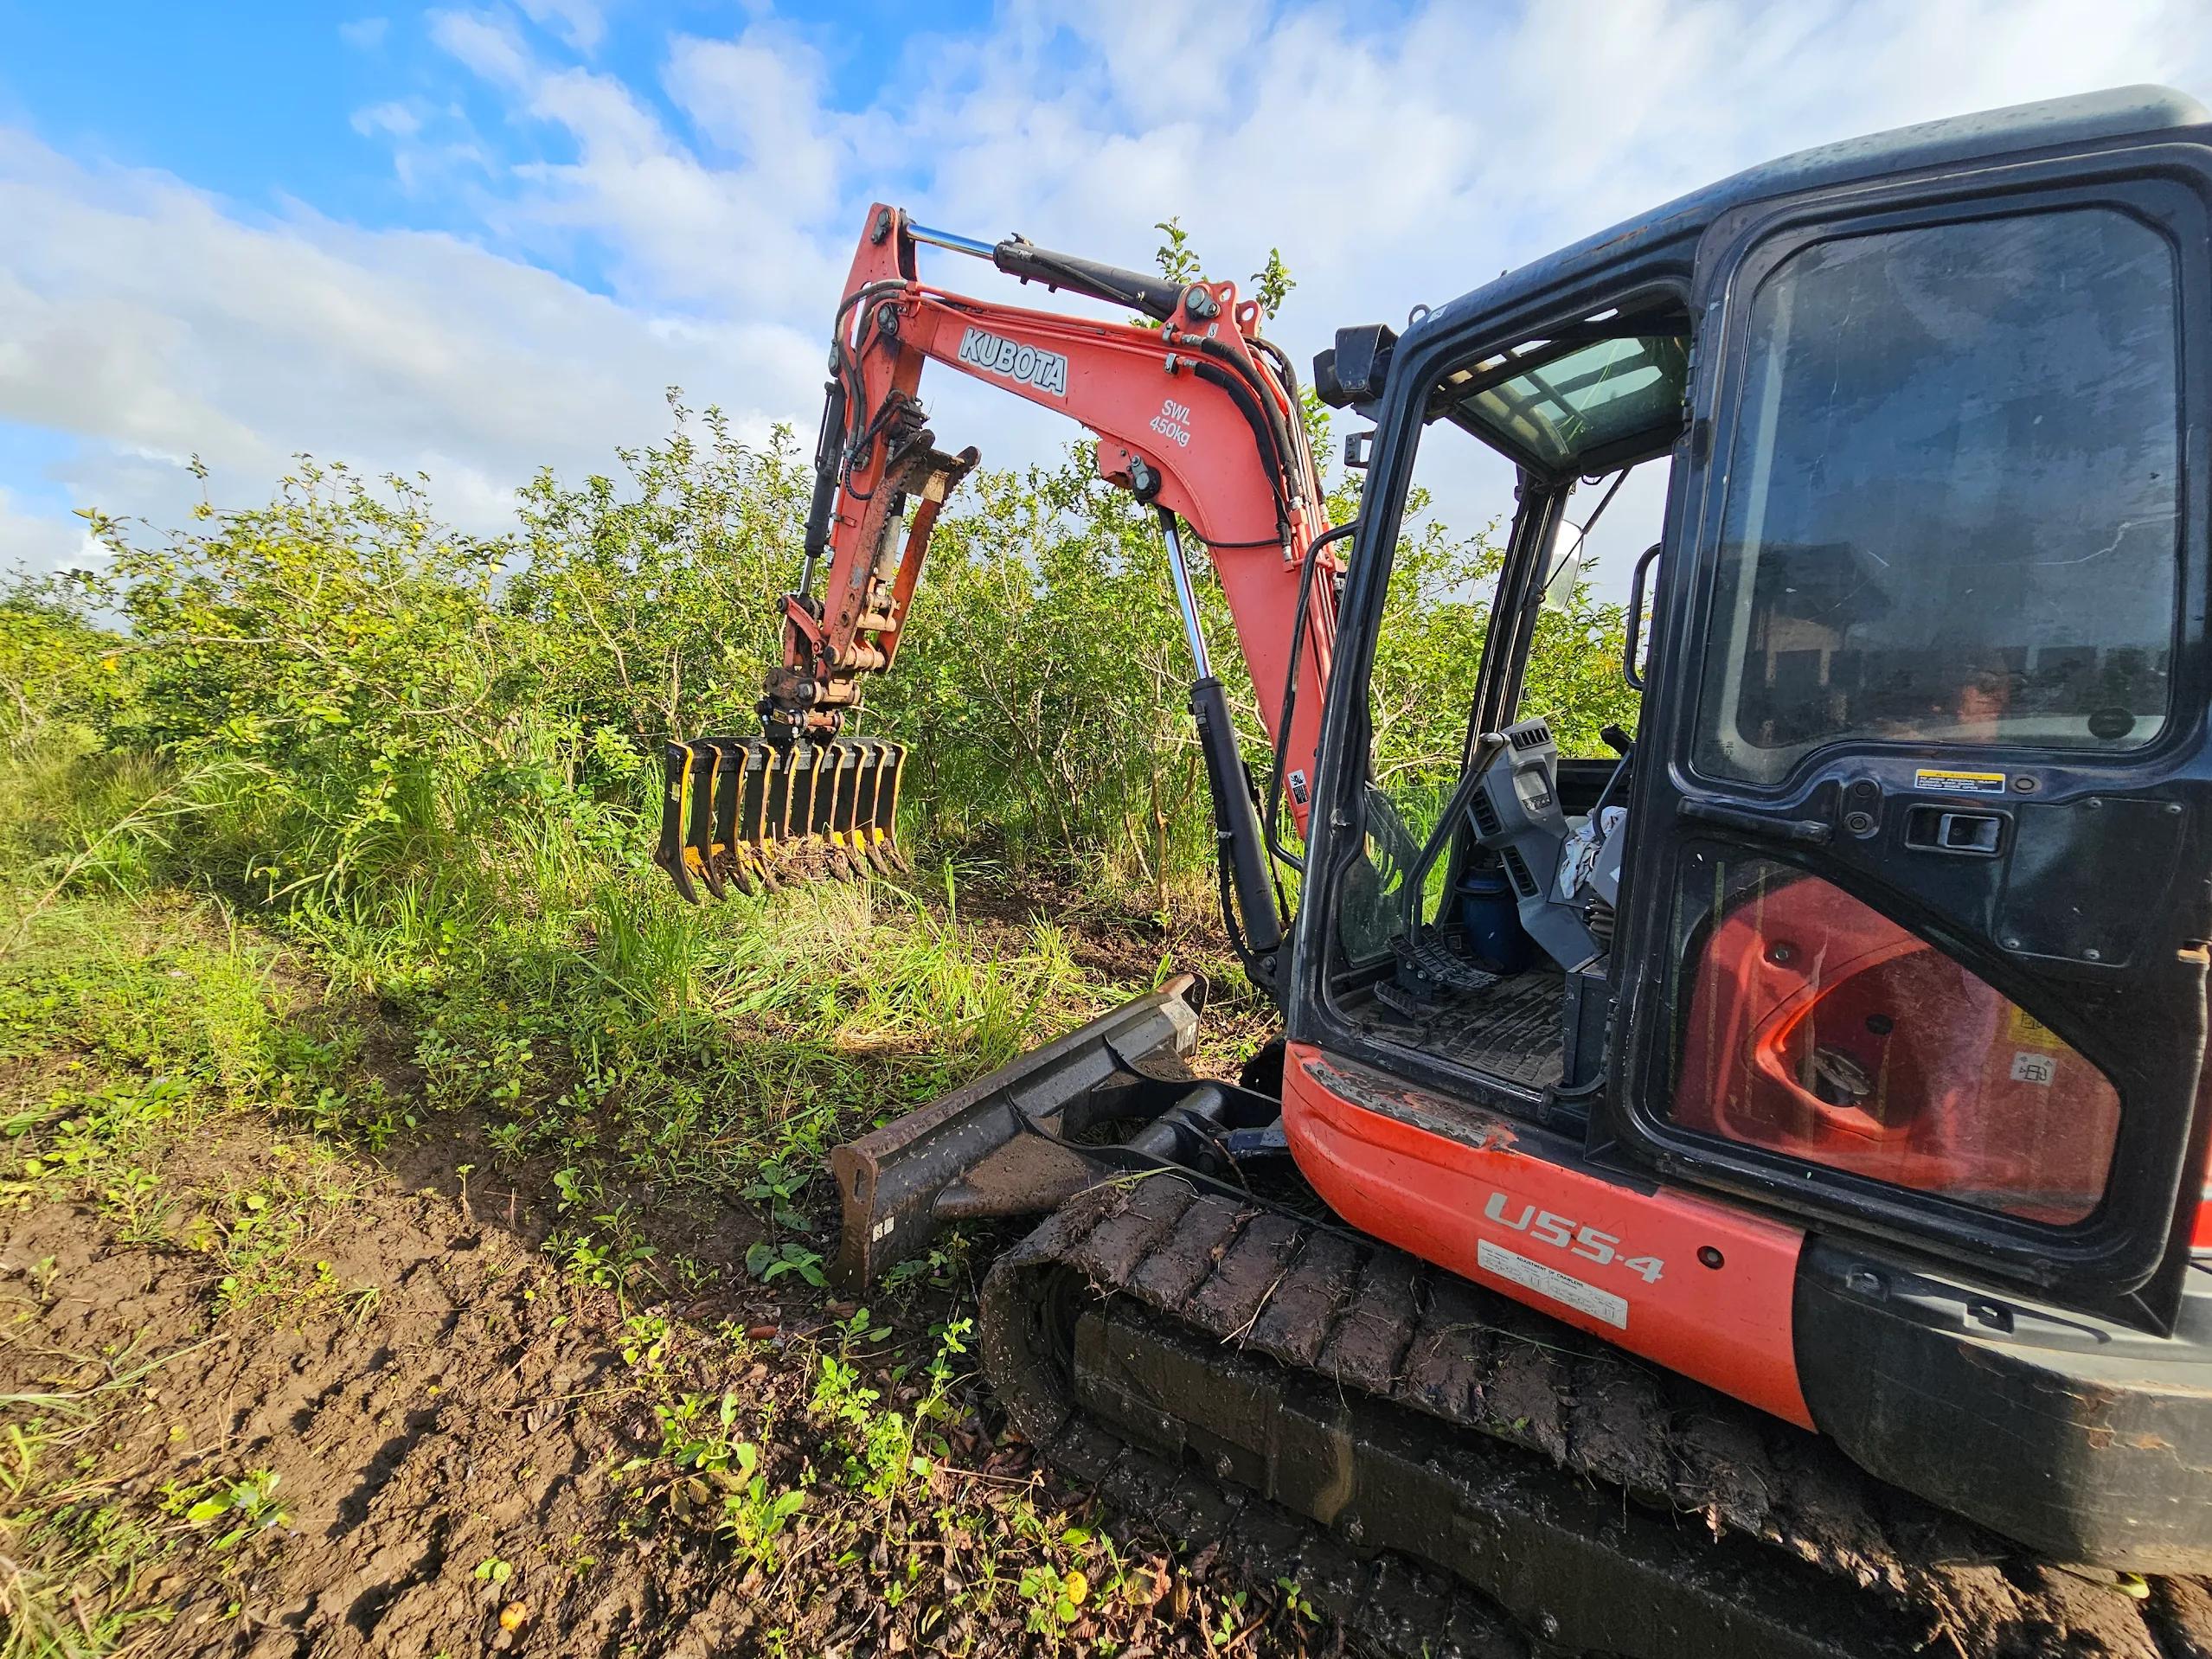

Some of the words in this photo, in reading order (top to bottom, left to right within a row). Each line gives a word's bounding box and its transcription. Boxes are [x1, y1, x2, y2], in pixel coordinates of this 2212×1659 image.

[959, 326, 1067, 394] KUBOTA
[1150, 415, 1190, 447] 450kg
[1162, 400, 1190, 426] SWL
[1484, 1192, 1664, 1284] U55-4
